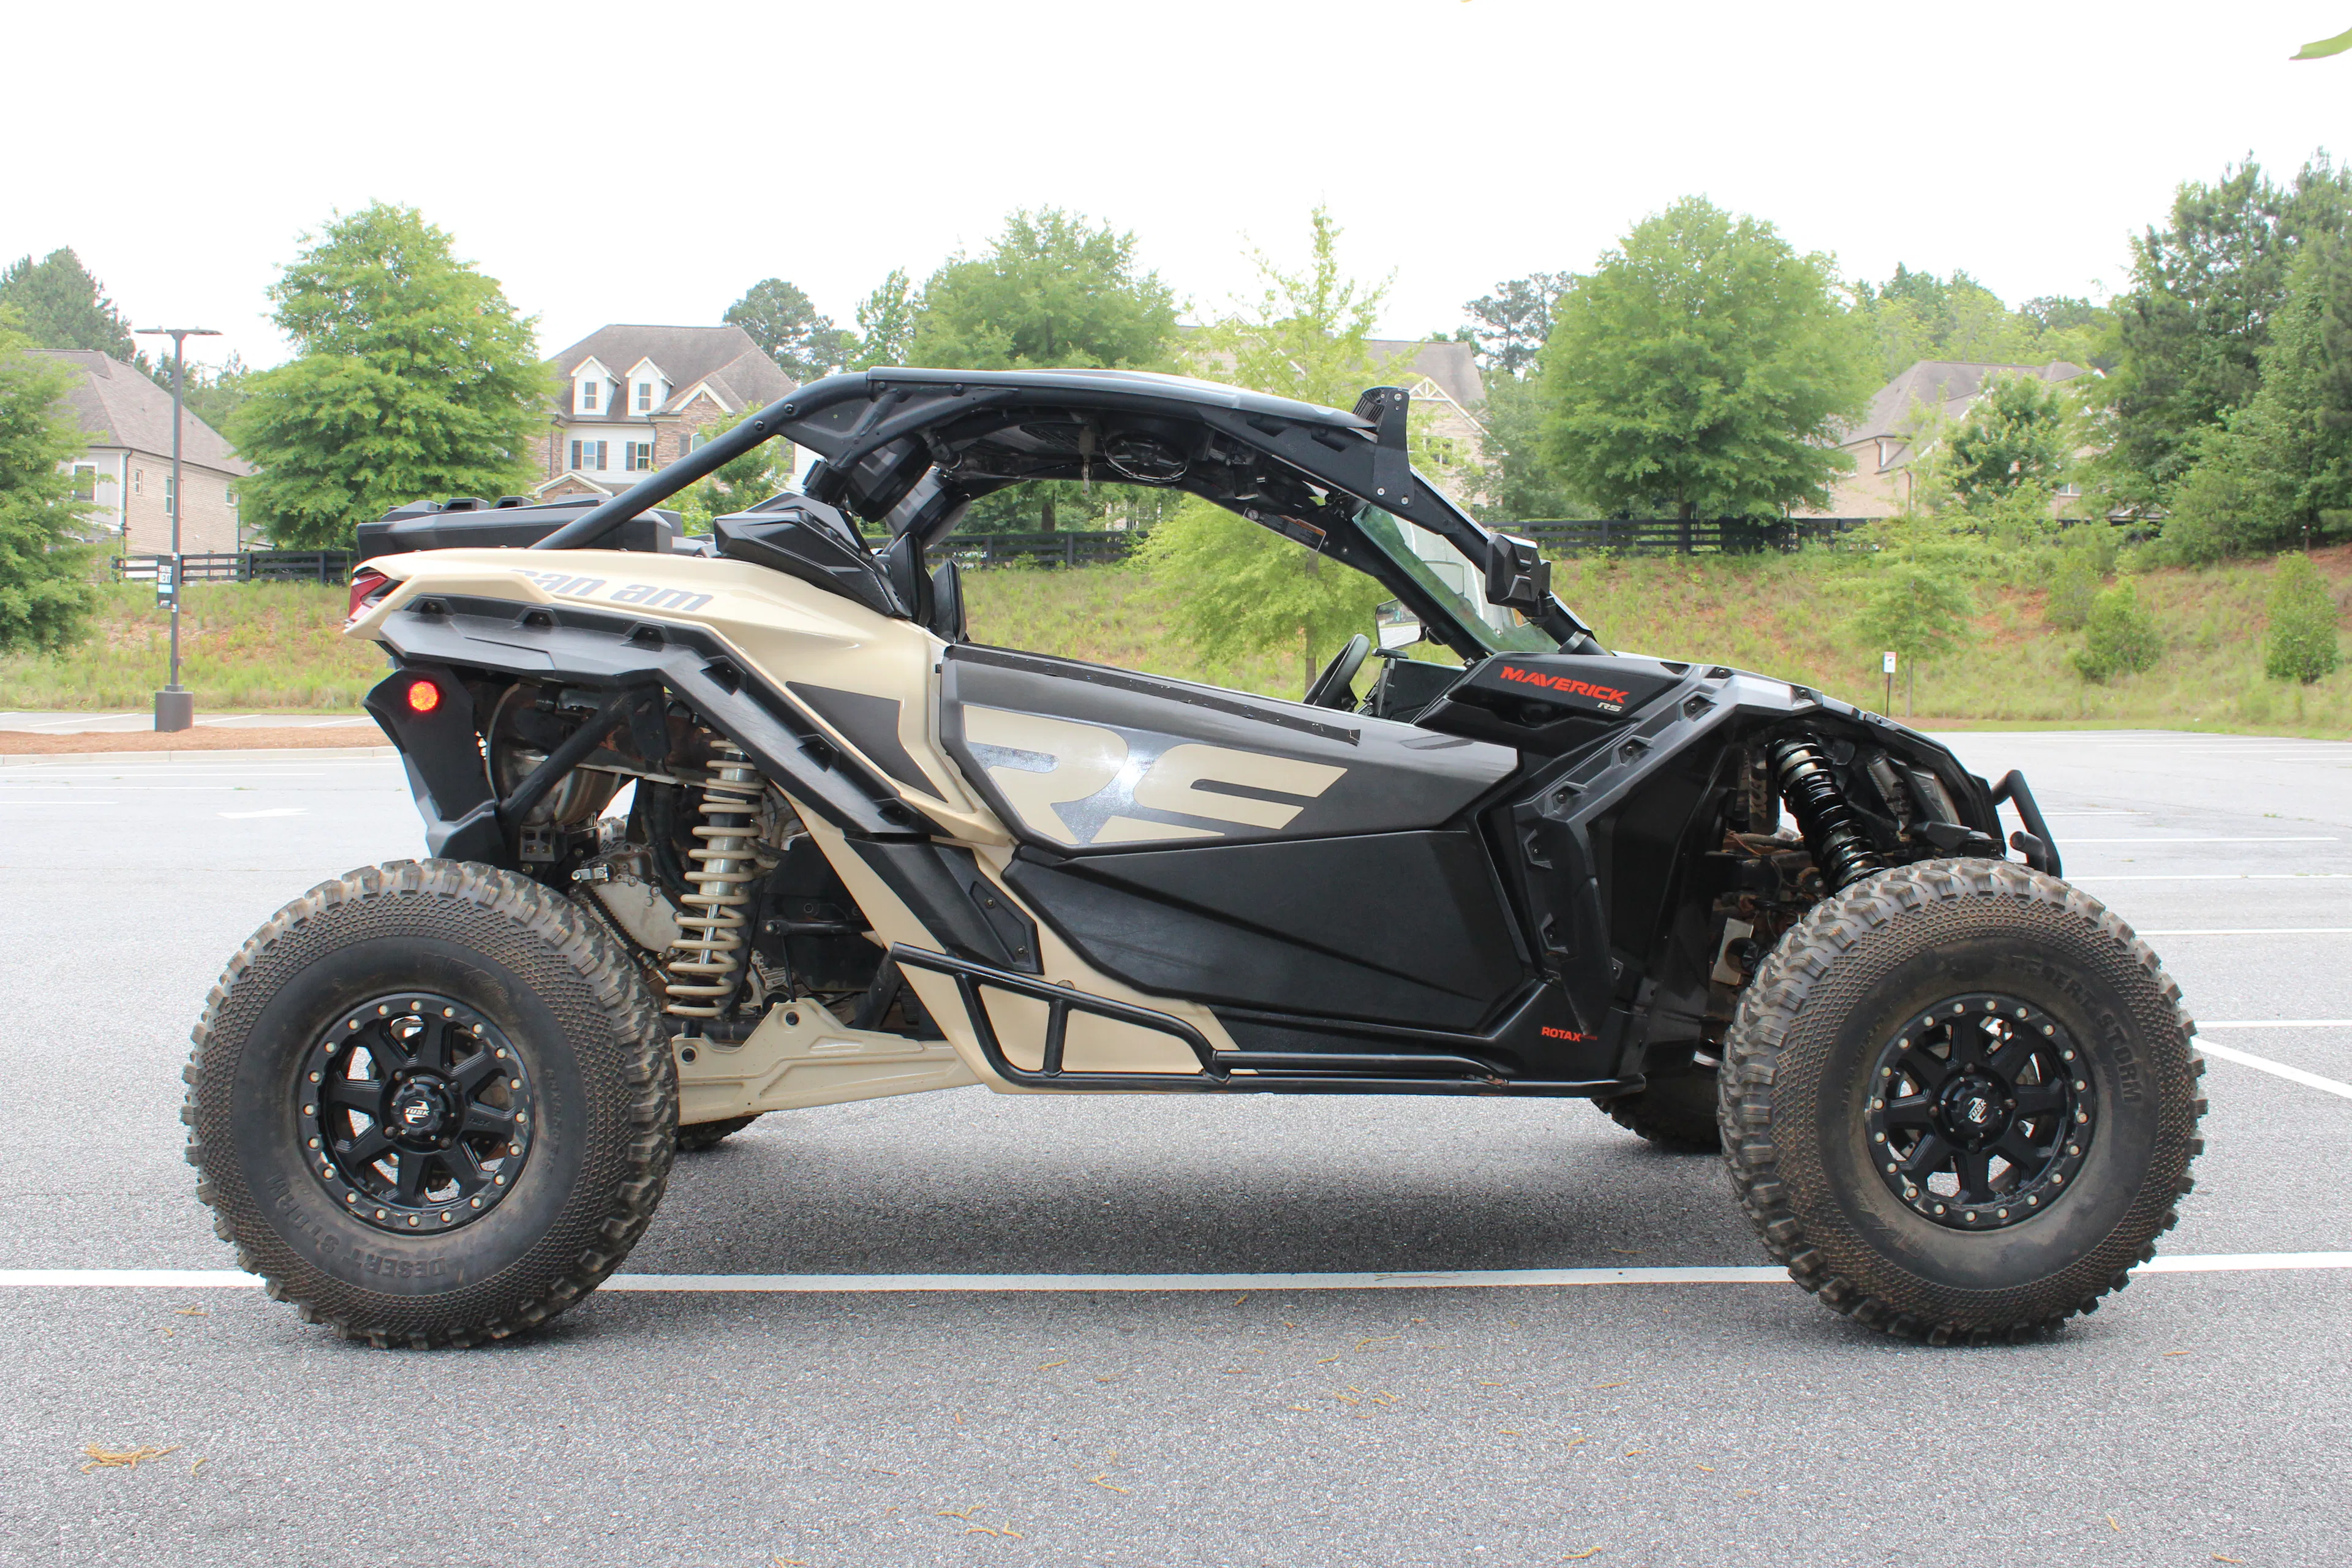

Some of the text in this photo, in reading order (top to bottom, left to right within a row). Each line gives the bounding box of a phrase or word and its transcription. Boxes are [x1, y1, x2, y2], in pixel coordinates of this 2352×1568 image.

[609, 584, 714, 612] am
[1500, 666, 1630, 704] MAVERICK
[1597, 701, 1623, 713] RS
[1749, 773, 1768, 819] FOX
[1541, 1027, 1581, 1042] ROTAX
[2096, 1012, 2143, 1102] STORM
[404, 1107, 430, 1117] TUSK
[1968, 1099, 1987, 1121] TUSK
[265, 1173, 339, 1253] STORM
[342, 1248, 446, 1278] DESERT
